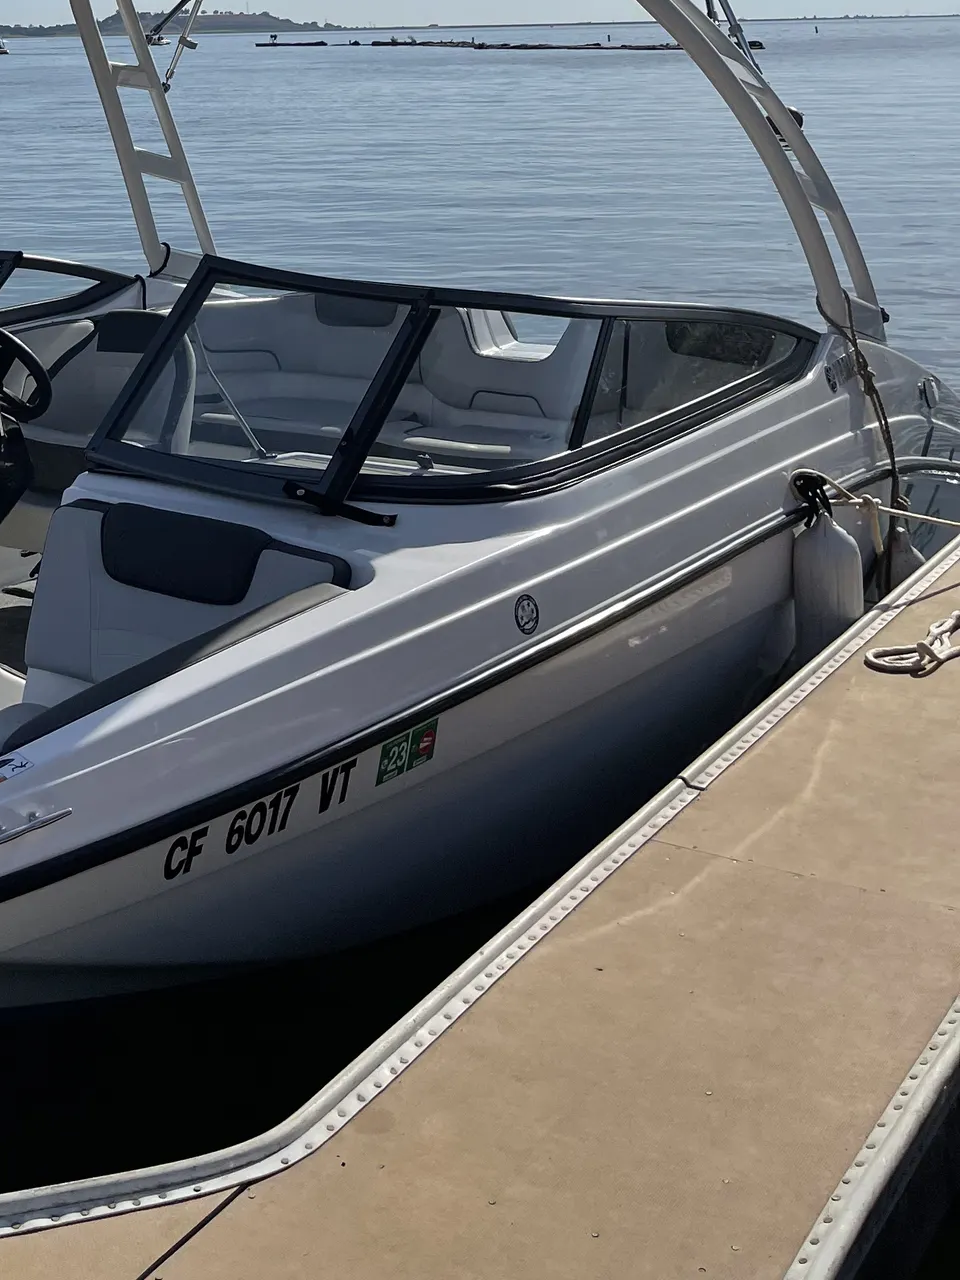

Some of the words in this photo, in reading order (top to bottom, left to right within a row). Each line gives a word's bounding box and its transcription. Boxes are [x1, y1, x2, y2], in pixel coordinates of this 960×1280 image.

[387, 741, 408, 771] 23
[164, 826, 209, 880] CF
[225, 783, 300, 855] 6017
[318, 758, 358, 814] VT
